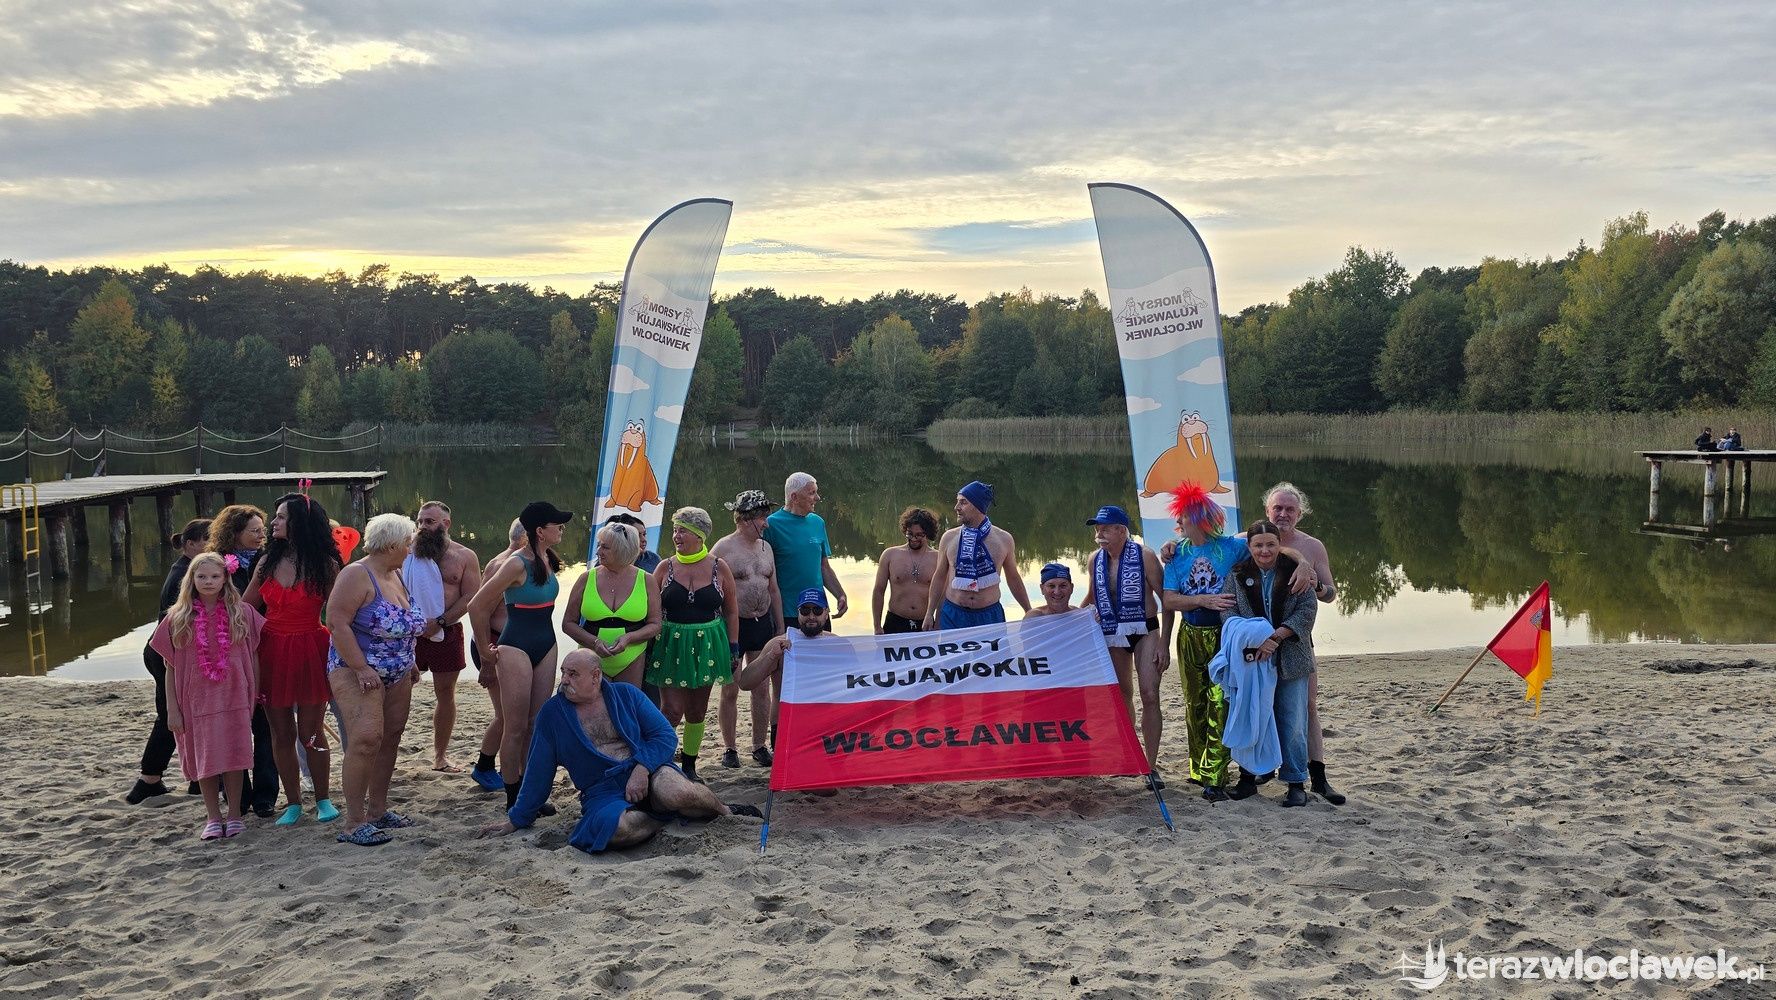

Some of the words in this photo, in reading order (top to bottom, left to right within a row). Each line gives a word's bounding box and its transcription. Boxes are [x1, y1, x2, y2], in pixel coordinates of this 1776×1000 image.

[648, 301, 683, 320] MORSY
[636, 312, 692, 338] KUJAWSKIE
[632, 325, 692, 352] WŁOCŁAWEK
[1120, 564, 1142, 603] MORSY
[884, 638, 1003, 663] MORSY
[821, 718, 1093, 756] WŁOCŁAWEK
